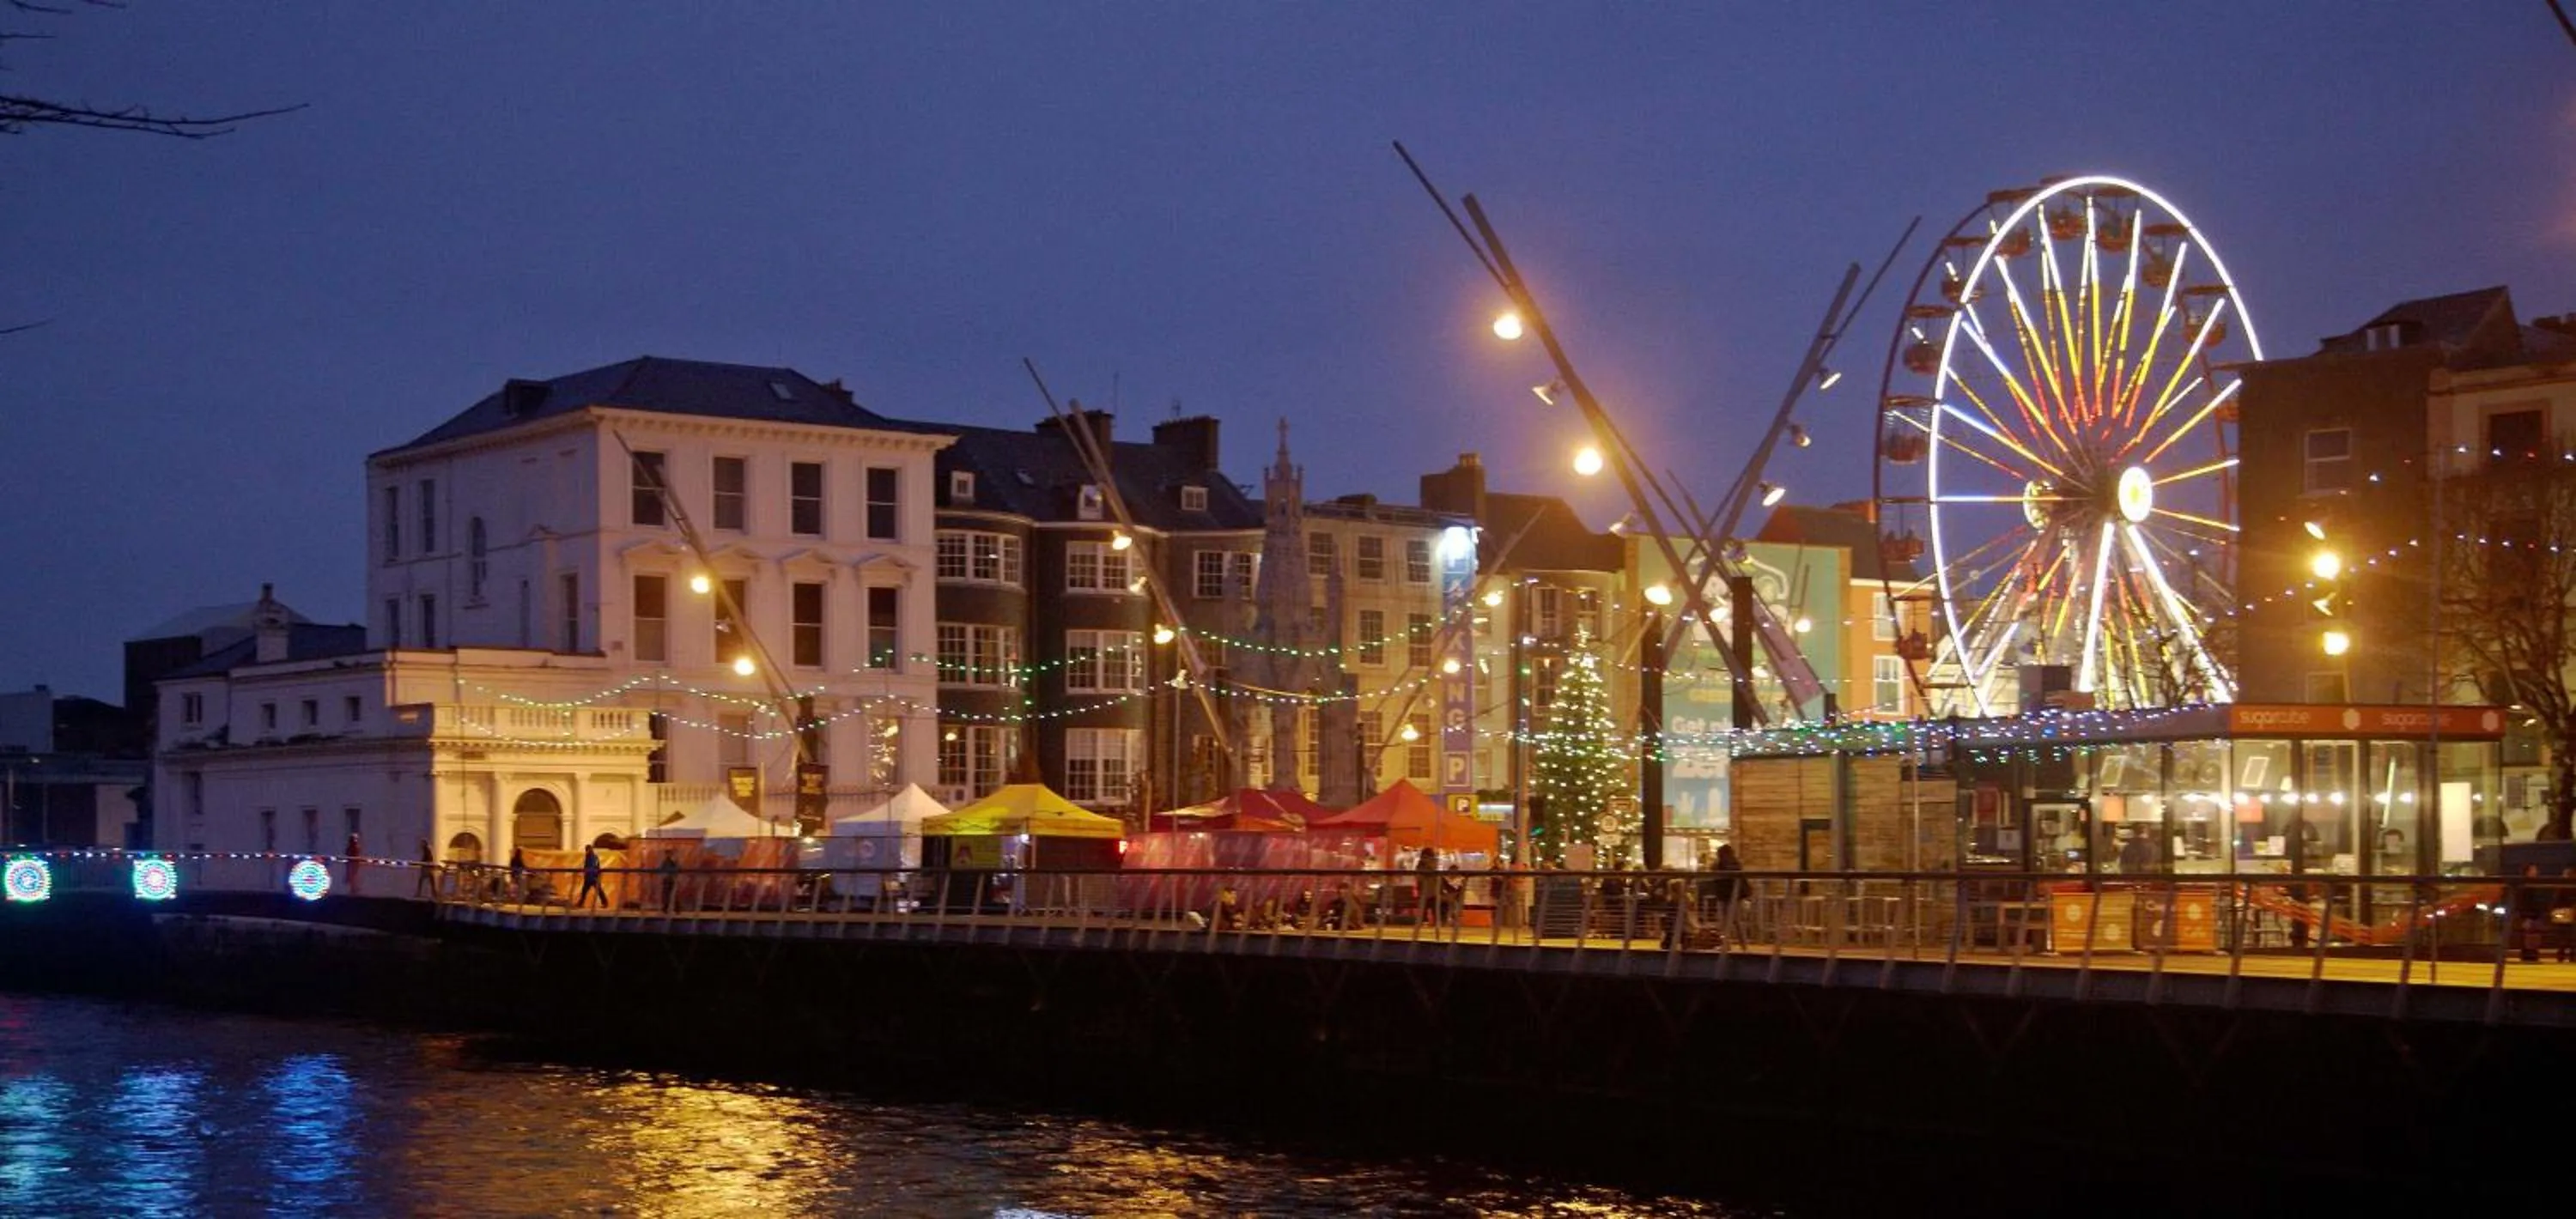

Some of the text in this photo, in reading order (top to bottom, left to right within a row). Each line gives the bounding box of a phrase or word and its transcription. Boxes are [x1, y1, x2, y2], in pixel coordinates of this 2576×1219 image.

[1446, 548, 1467, 728] ARKNG
[2382, 713, 2453, 731] sugarce
[1448, 757, 1465, 782] P
[1456, 797, 1470, 812] P
